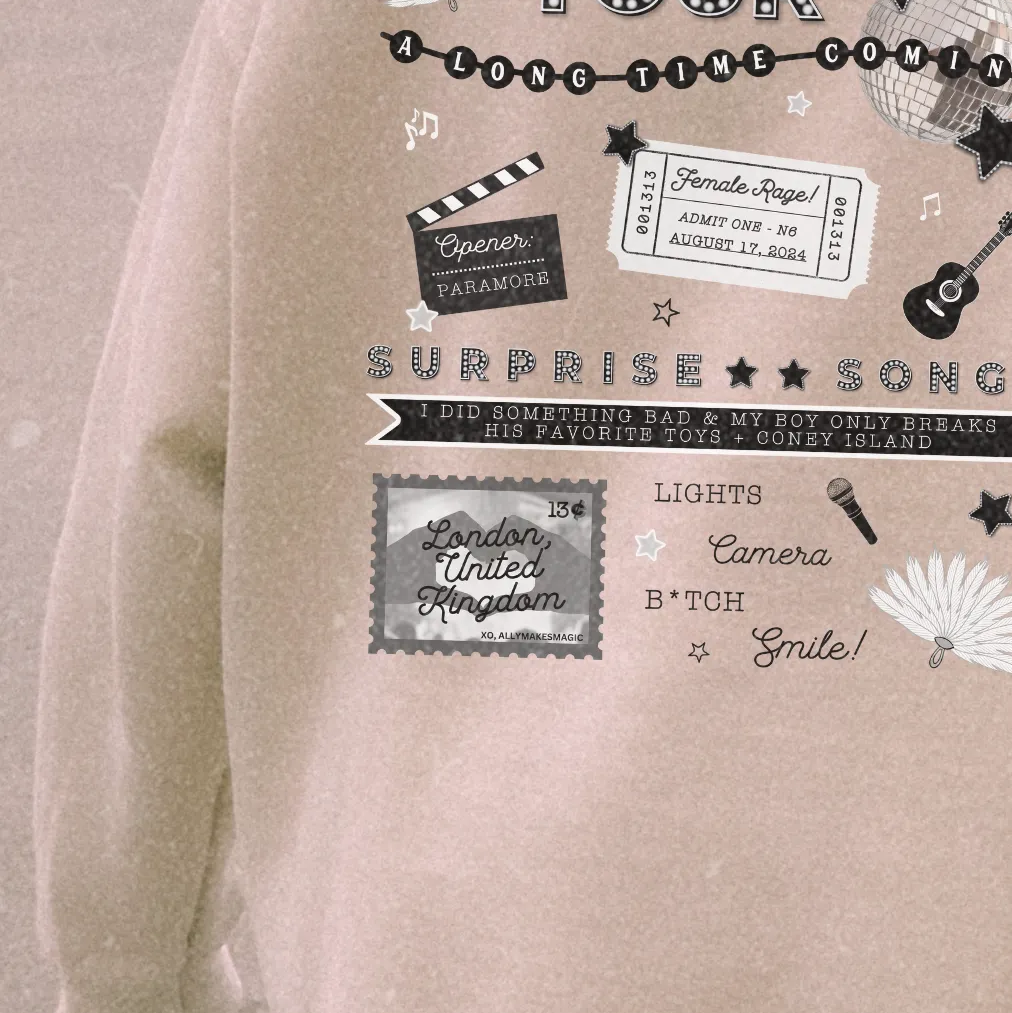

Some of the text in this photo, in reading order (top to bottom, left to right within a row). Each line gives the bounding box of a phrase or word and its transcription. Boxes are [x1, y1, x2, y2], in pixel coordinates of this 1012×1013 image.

[454, 51, 586, 88] LONG
[636, 49, 766, 87] TIME
[636, 170, 657, 234] 001313
[671, 167, 820, 206] Female Rage!
[678, 212, 728, 228] ADMIT
[731, 218, 763, 233] ONE
[777, 224, 798, 237] N6
[827, 196, 847, 261] 001313
[435, 233, 534, 262] Opener:
[669, 233, 807, 262] AUGUST 17, 2024
[437, 271, 549, 297] PARAMORE
[366, 345, 703, 386] SURPRISE
[421, 404, 997, 433] I DID SOMETHING BAD & MY BOY ONLY BREAKS
[484, 423, 932, 449] HIS FAVORITE TOYS + CONEY ISLAND
[654, 482, 762, 505] LIGHTS
[548, 500, 587, 521] 13¢
[422, 517, 552, 551] London,
[709, 534, 832, 566] Camera
[435, 548, 546, 583] United
[418, 582, 566, 624] Kingdom
[481, 631, 584, 642] XO, ALLYMAKESMAGIC
[752, 627, 868, 668] Smile!
